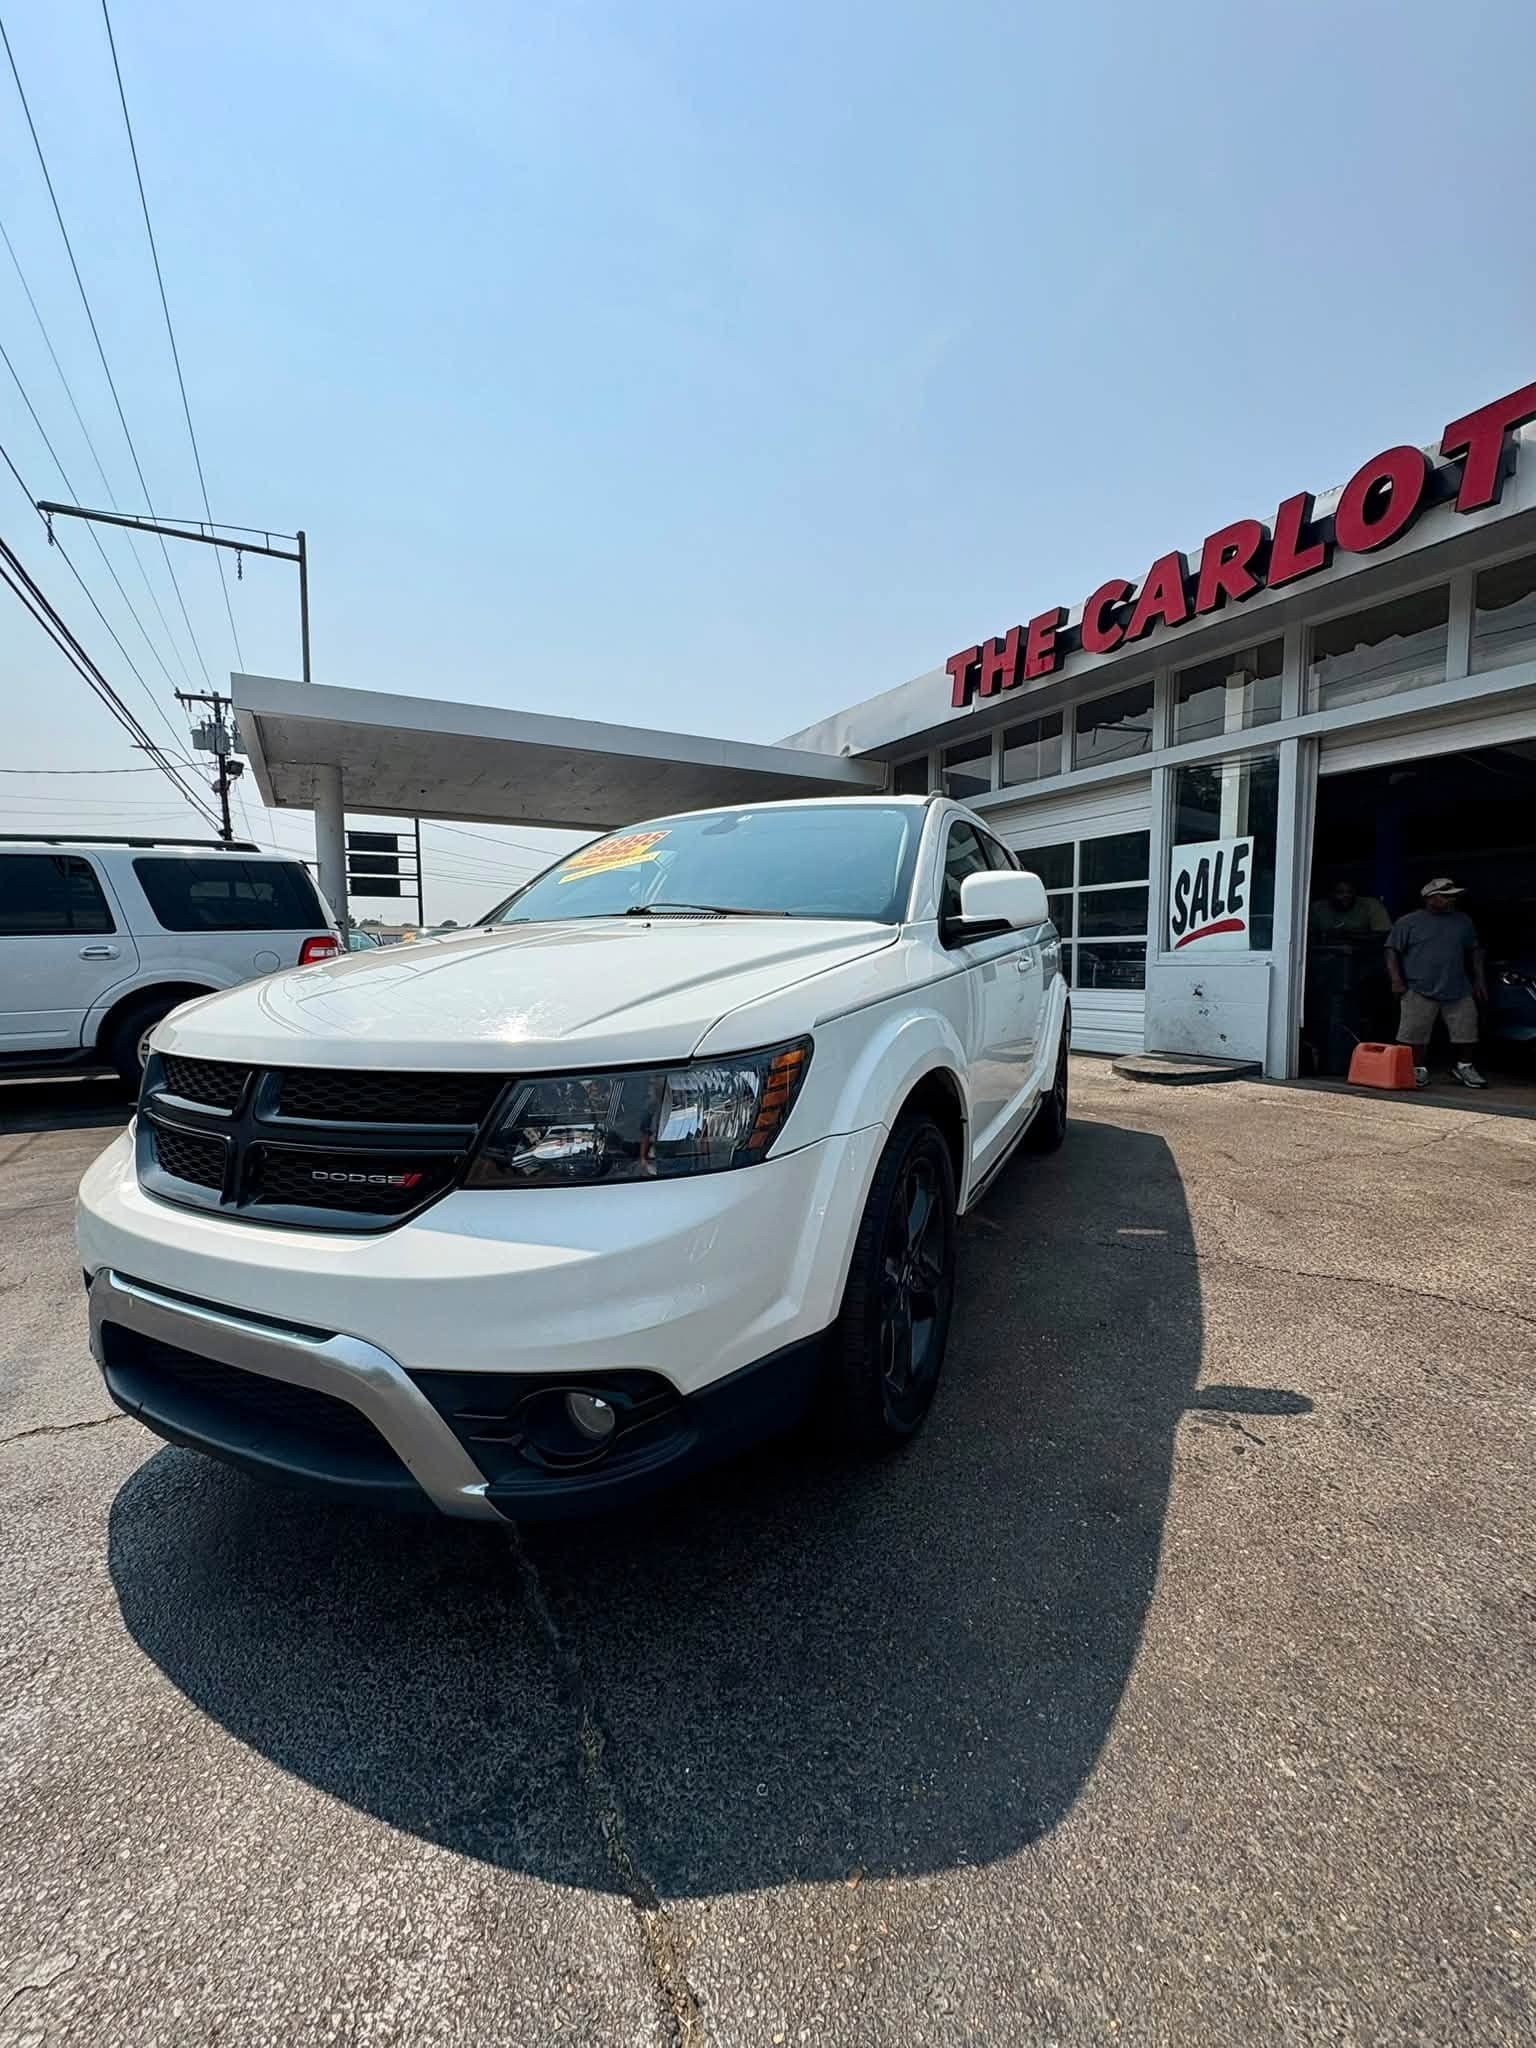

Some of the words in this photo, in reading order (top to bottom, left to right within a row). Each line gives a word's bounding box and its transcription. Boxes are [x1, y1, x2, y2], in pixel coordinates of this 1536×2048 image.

[946, 606, 1066, 707] THE
[1080, 381, 1536, 654] CARLOT
[1172, 844, 1249, 936] SALE
[311, 1170, 406, 1185] DODGE
